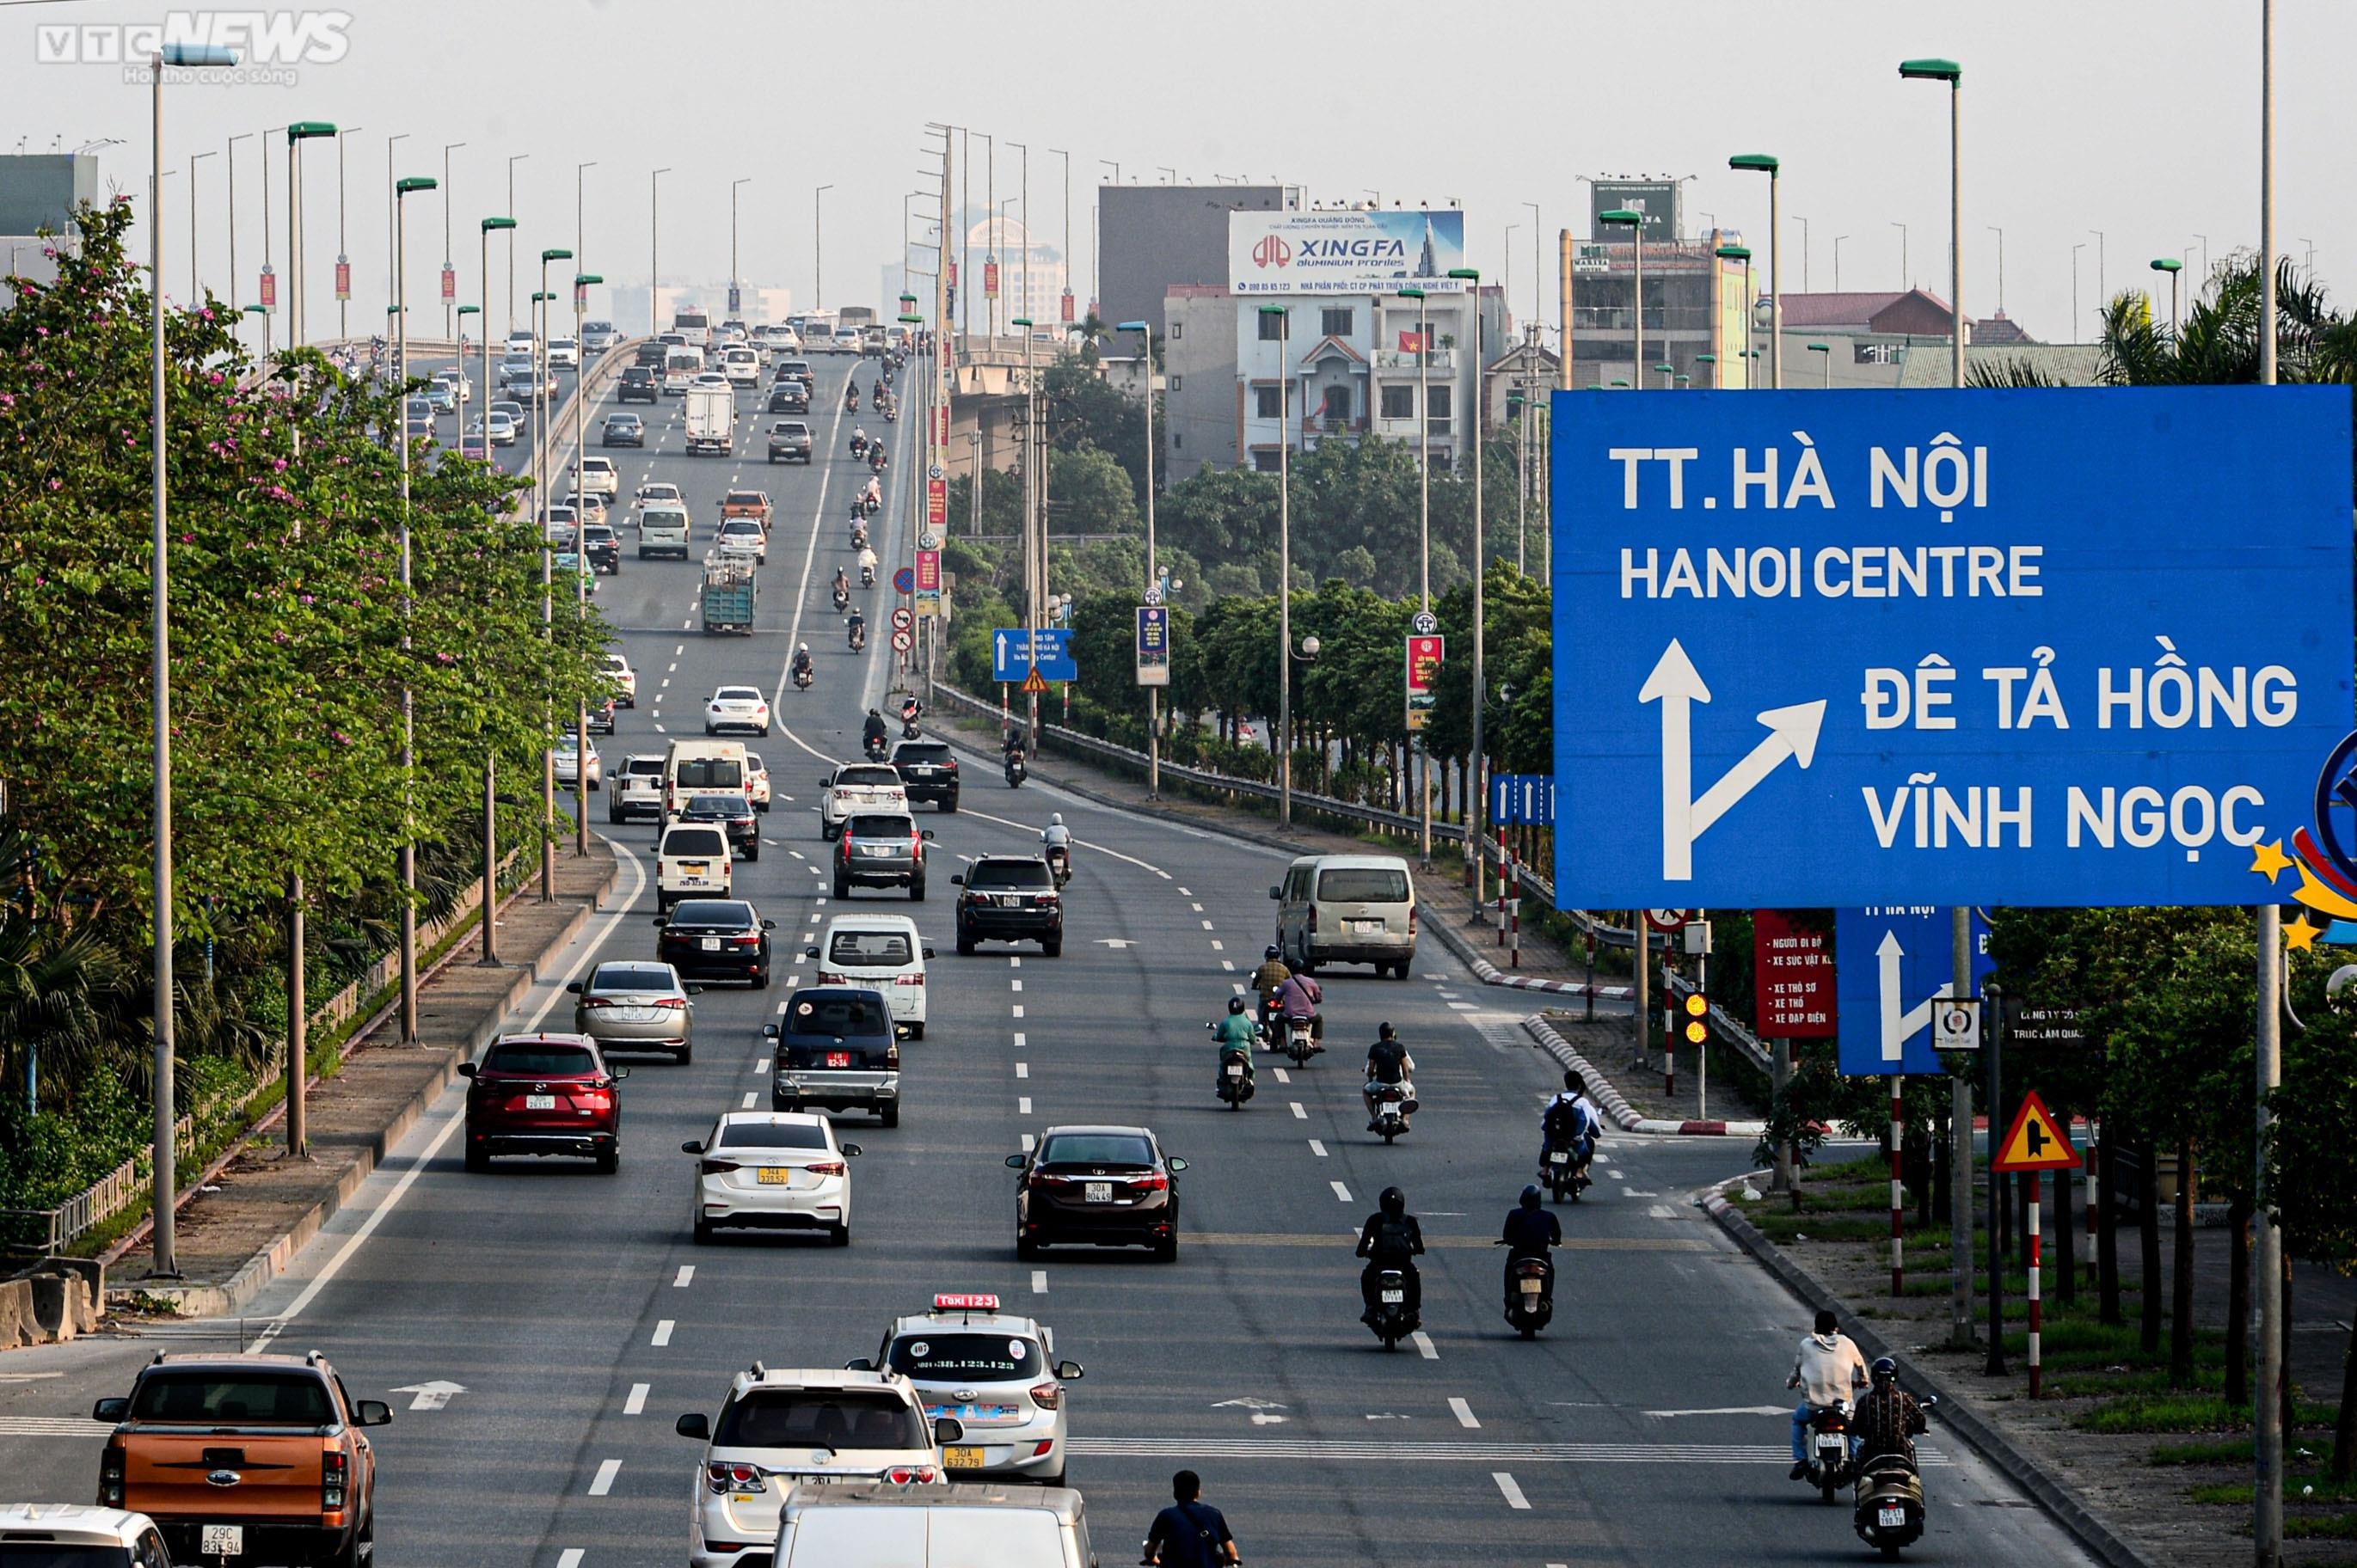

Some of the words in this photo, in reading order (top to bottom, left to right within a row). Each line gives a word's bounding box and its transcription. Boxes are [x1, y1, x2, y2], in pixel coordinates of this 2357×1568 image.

[1298, 239, 1405, 257] XINGFA
[1870, 432, 1987, 524] NỘI
[1621, 547, 1802, 598] HANOI
[1814, 546, 2043, 598] CENTRE
[1861, 652, 1956, 731] ĐÊ
[1982, 646, 2070, 730] TẢ
[2098, 635, 2298, 730] HỒNG
[1862, 772, 2032, 848] VĨNH
[2067, 785, 2265, 863] NGỌC
[1772, 936, 1797, 948] NGƯỜI
[1772, 956, 1783, 965] XE
[1774, 983, 1785, 993] XE
[1775, 999, 1785, 1008] XE
[1775, 1014, 1785, 1024] XE
[1091, 1184, 1106, 1192] 30A
[939, 1295, 964, 1306] Taxi
[954, 1449, 973, 1458] 30A
[212, 1527, 233, 1540] 29C
